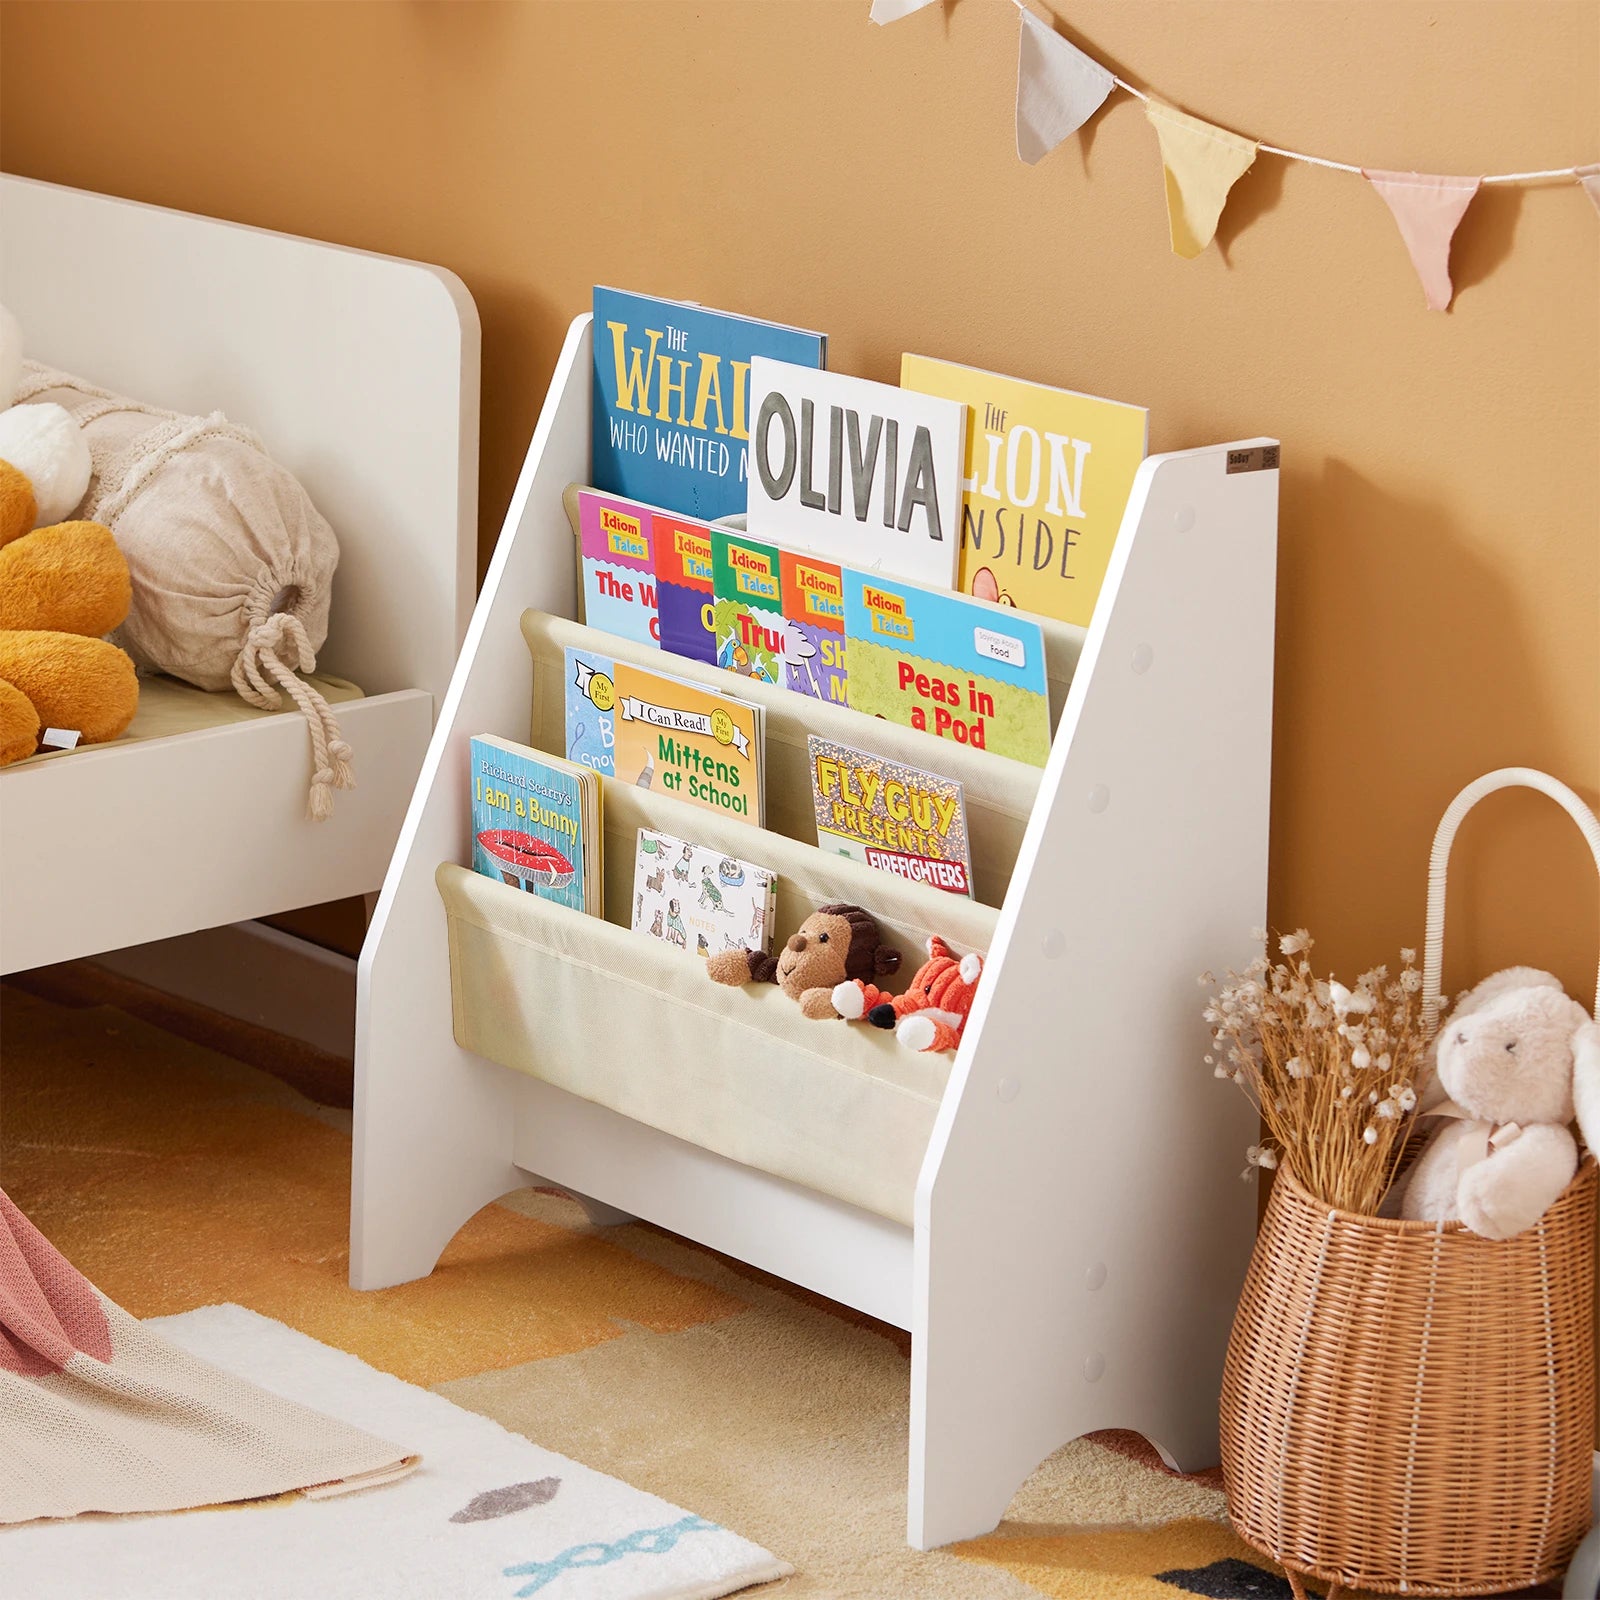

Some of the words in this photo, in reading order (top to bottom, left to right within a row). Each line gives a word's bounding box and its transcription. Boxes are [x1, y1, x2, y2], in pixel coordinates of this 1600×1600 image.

[666, 325, 689, 352] THE
[985, 402, 1009, 434] THE
[610, 416, 648, 455] WHO
[655, 428, 730, 477] WANTED
[755, 391, 943, 541] OLIVIA
[603, 512, 638, 536] Idiom
[612, 535, 644, 555] Tales
[678, 535, 712, 559] Idiom
[731, 550, 767, 574] Idiom
[595, 570, 634, 602] The
[741, 573, 774, 595] Tales
[800, 570, 837, 594] Idiom
[810, 594, 844, 616] Tales
[866, 590, 902, 614] Idiom
[737, 613, 785, 654] Tru
[876, 614, 909, 636] Tales
[990, 644, 1009, 658] Food
[594, 690, 610, 702] First
[596, 681, 608, 693] My
[897, 660, 960, 707] Peas
[968, 679, 995, 718] in
[639, 704, 645, 718] I
[647, 707, 671, 726] Can
[674, 712, 706, 732] Read!
[715, 725, 730, 737] First
[716, 717, 727, 729] My
[910, 706, 926, 732] a
[933, 705, 987, 750] Pod
[658, 734, 740, 787] Mittens
[480, 759, 527, 789] Richard
[528, 778, 573, 807] Scarry's
[662, 772, 683, 791] at
[689, 775, 748, 816] School
[816, 755, 880, 811] FLY
[884, 779, 956, 837] GUY
[476, 777, 482, 802] I
[485, 787, 511, 812] am
[515, 798, 526, 818] a
[529, 797, 579, 846] Bunny
[832, 802, 941, 859] PRESENTS
[869, 852, 965, 889] FIREFIGHTERS
[689, 915, 716, 933] NOTES
